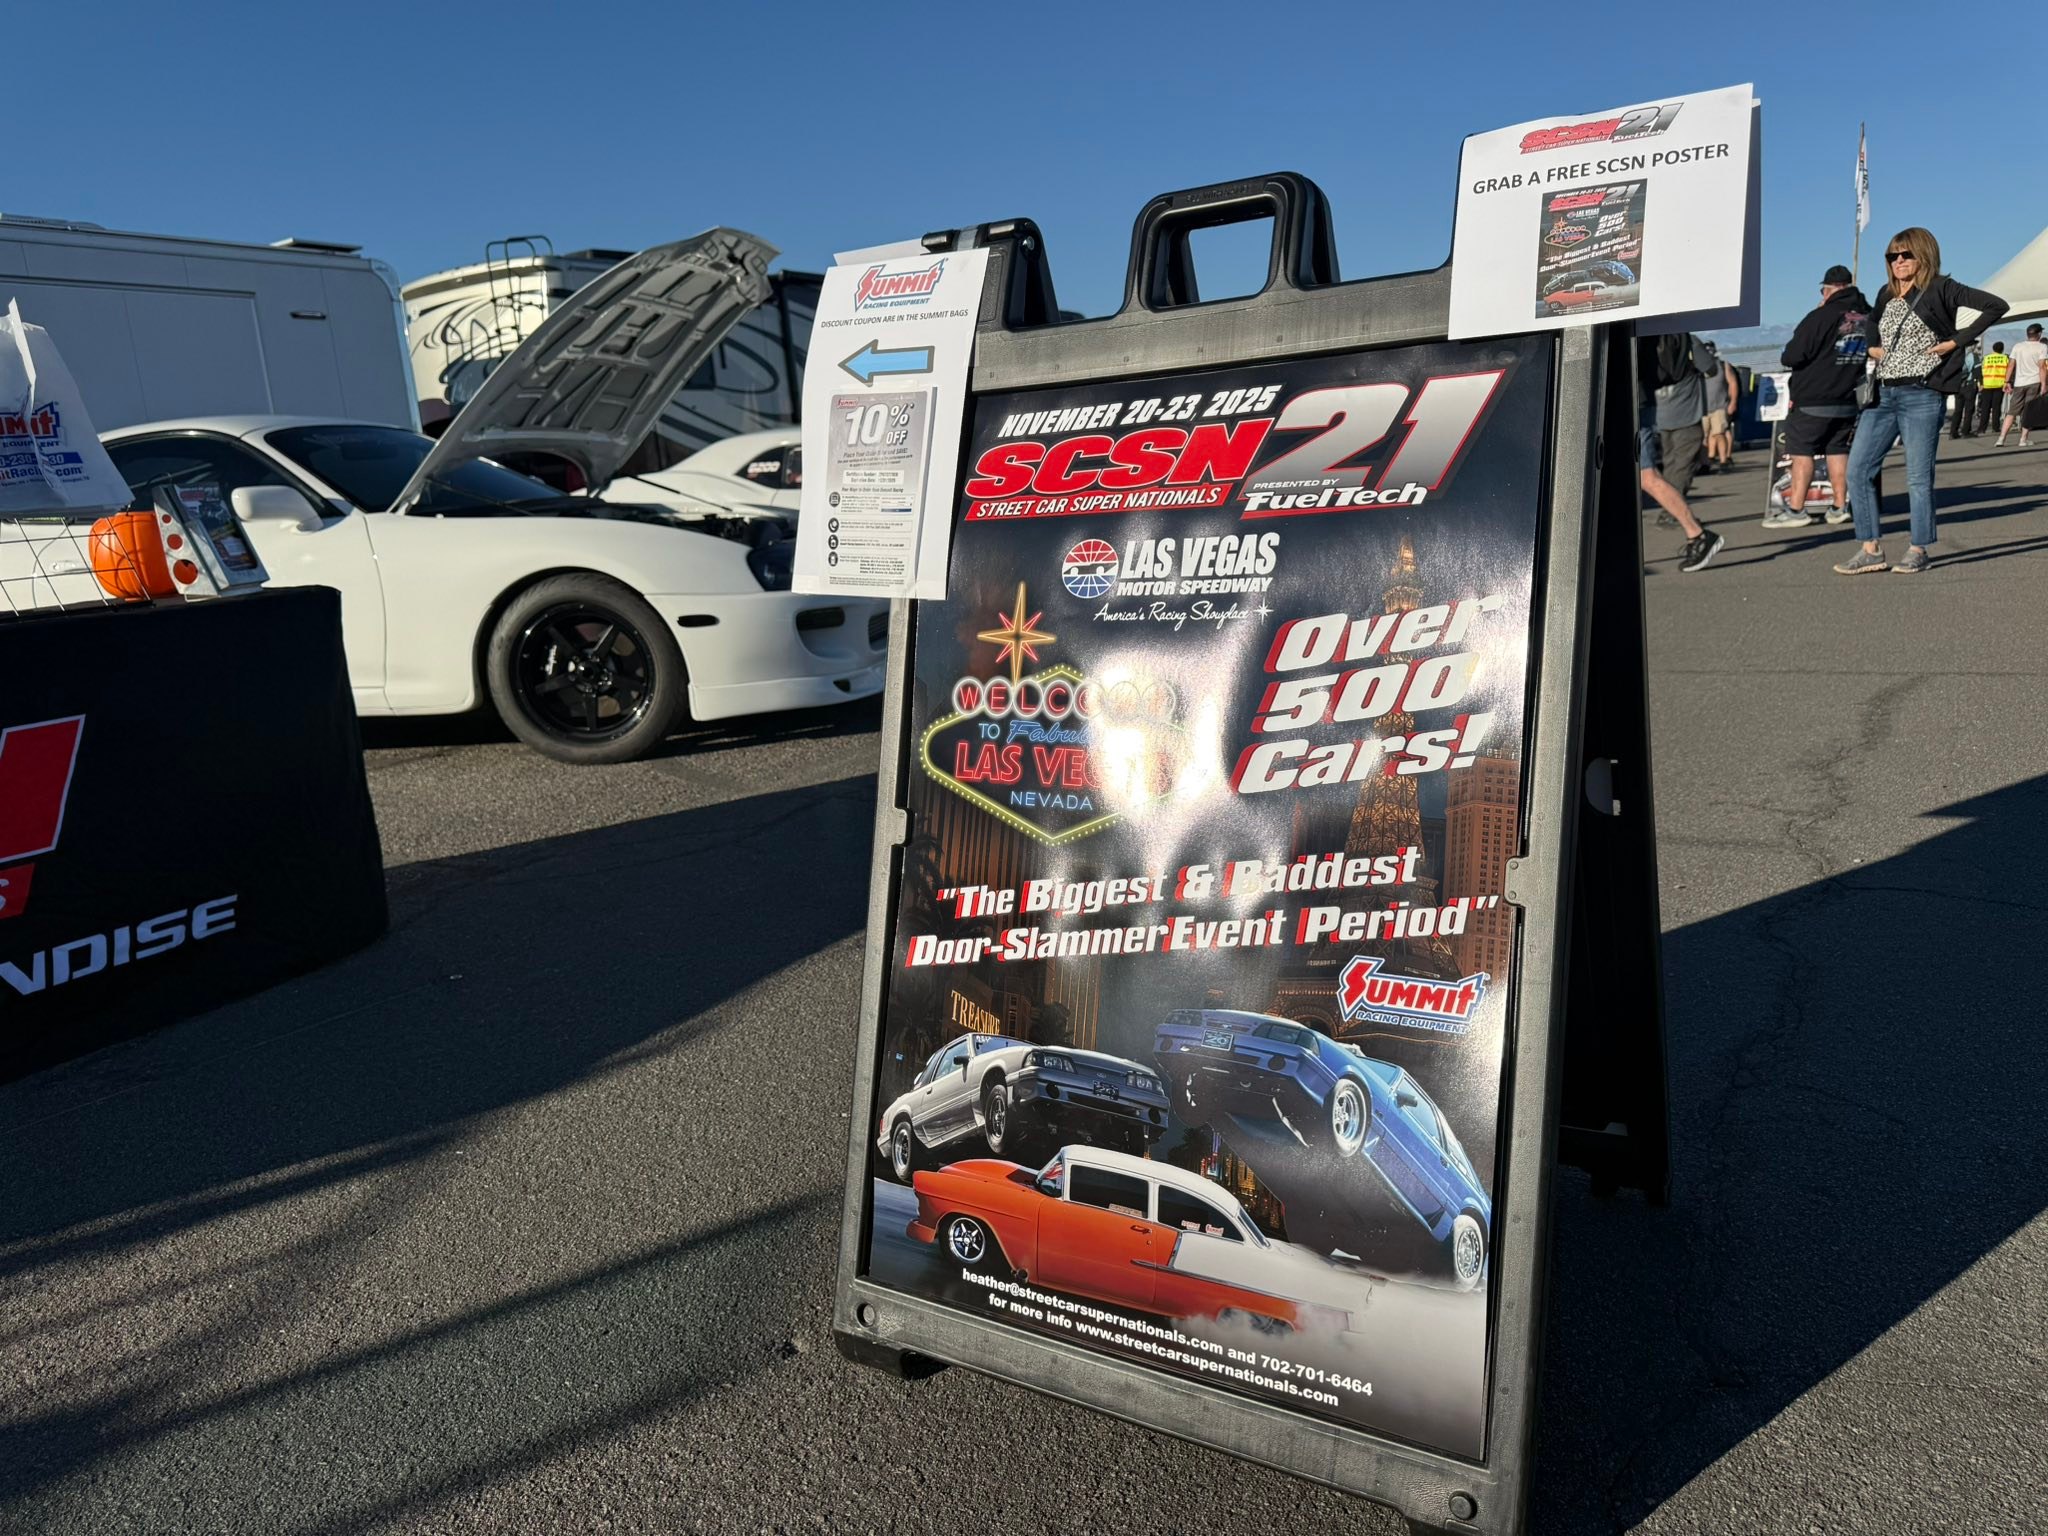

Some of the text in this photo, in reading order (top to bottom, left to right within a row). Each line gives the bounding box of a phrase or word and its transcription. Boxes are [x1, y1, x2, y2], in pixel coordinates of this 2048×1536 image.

[1519, 102, 1684, 149] SCSN 21
[1473, 143, 1730, 195] GRAB A FREE SCSN POSTER
[1594, 222, 1626, 237] Cars!
[1600, 210, 1627, 223] Over
[821, 308, 969, 329] DISCOUNT COUPON ARE IN THE SUMMIT BAGS
[863, 297, 930, 310] RACING EQUIPMENT
[998, 402, 1123, 438] NOVEMBER
[1201, 384, 1283, 418] 2025
[885, 430, 907, 446] OFF
[965, 368, 1506, 501] SCSN 21
[1244, 482, 1428, 512] FuelTech
[1252, 477, 1341, 490] PRESENTED BY
[976, 487, 1222, 518] STREET CAR SUPER NATIONALS
[1120, 532, 1281, 579] LAS VEGAS
[1116, 576, 1274, 597] MOTOR SPEEDWAY
[1092, 600, 1250, 631] America's Racing Showplace
[1264, 593, 1505, 673] Over
[1252, 651, 1480, 733] 500
[978, 723, 1001, 740] TO
[954, 742, 1023, 783] LAS
[1231, 711, 1496, 794] Cars!
[1010, 790, 1093, 811] NEVADA
[938, 846, 1421, 919] "The Biggest & Baddest
[1295, 894, 1499, 945] Period"
[1356, 1010, 1468, 1034] RACING EQUIPMENT
[962, 1268, 1374, 1397] heather@streetcarsupernationals.com and 702-701-6464
[988, 1293, 1340, 1407] for more info www.streetcarsupernationals.com
